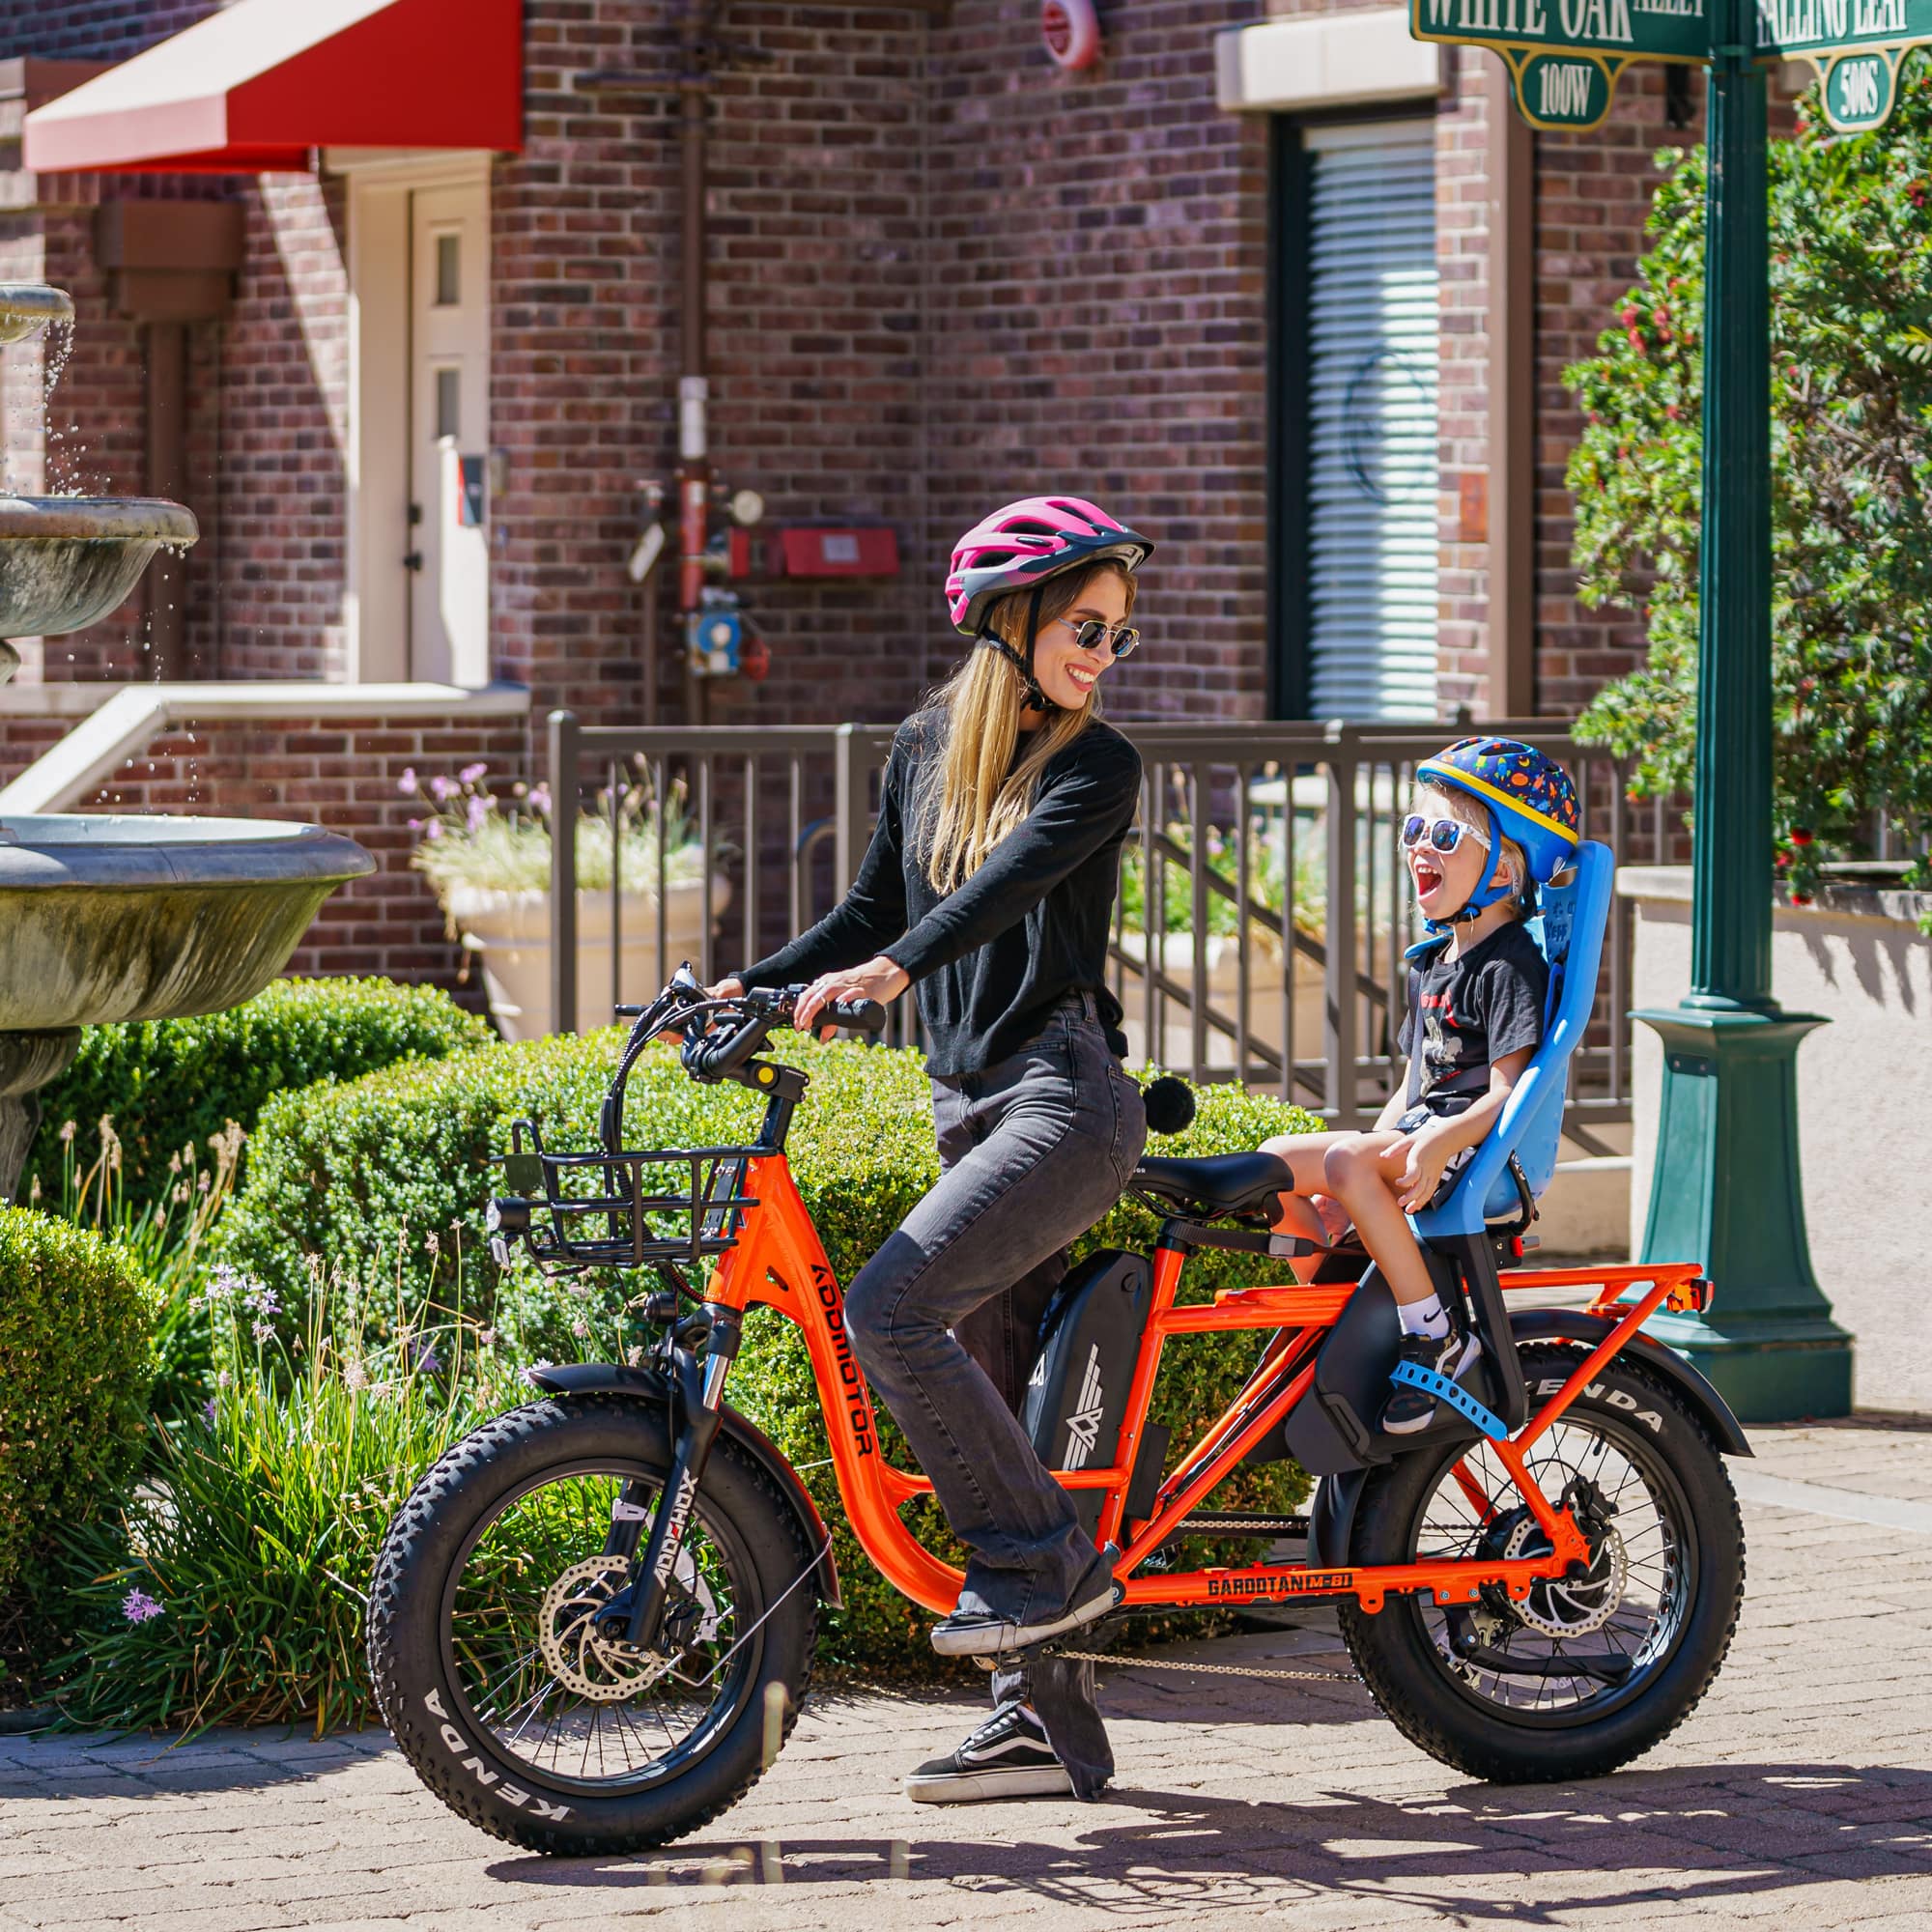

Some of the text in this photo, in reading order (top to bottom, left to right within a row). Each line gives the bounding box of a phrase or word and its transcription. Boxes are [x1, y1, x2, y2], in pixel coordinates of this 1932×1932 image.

[1539, 63, 1593, 116] 100W
[1839, 60, 1879, 117] 500S
[810, 1264, 873, 1459] ADDMOTOR
[1524, 1378, 1663, 1434] ENDA
[424, 1688, 571, 1822] KENDA
